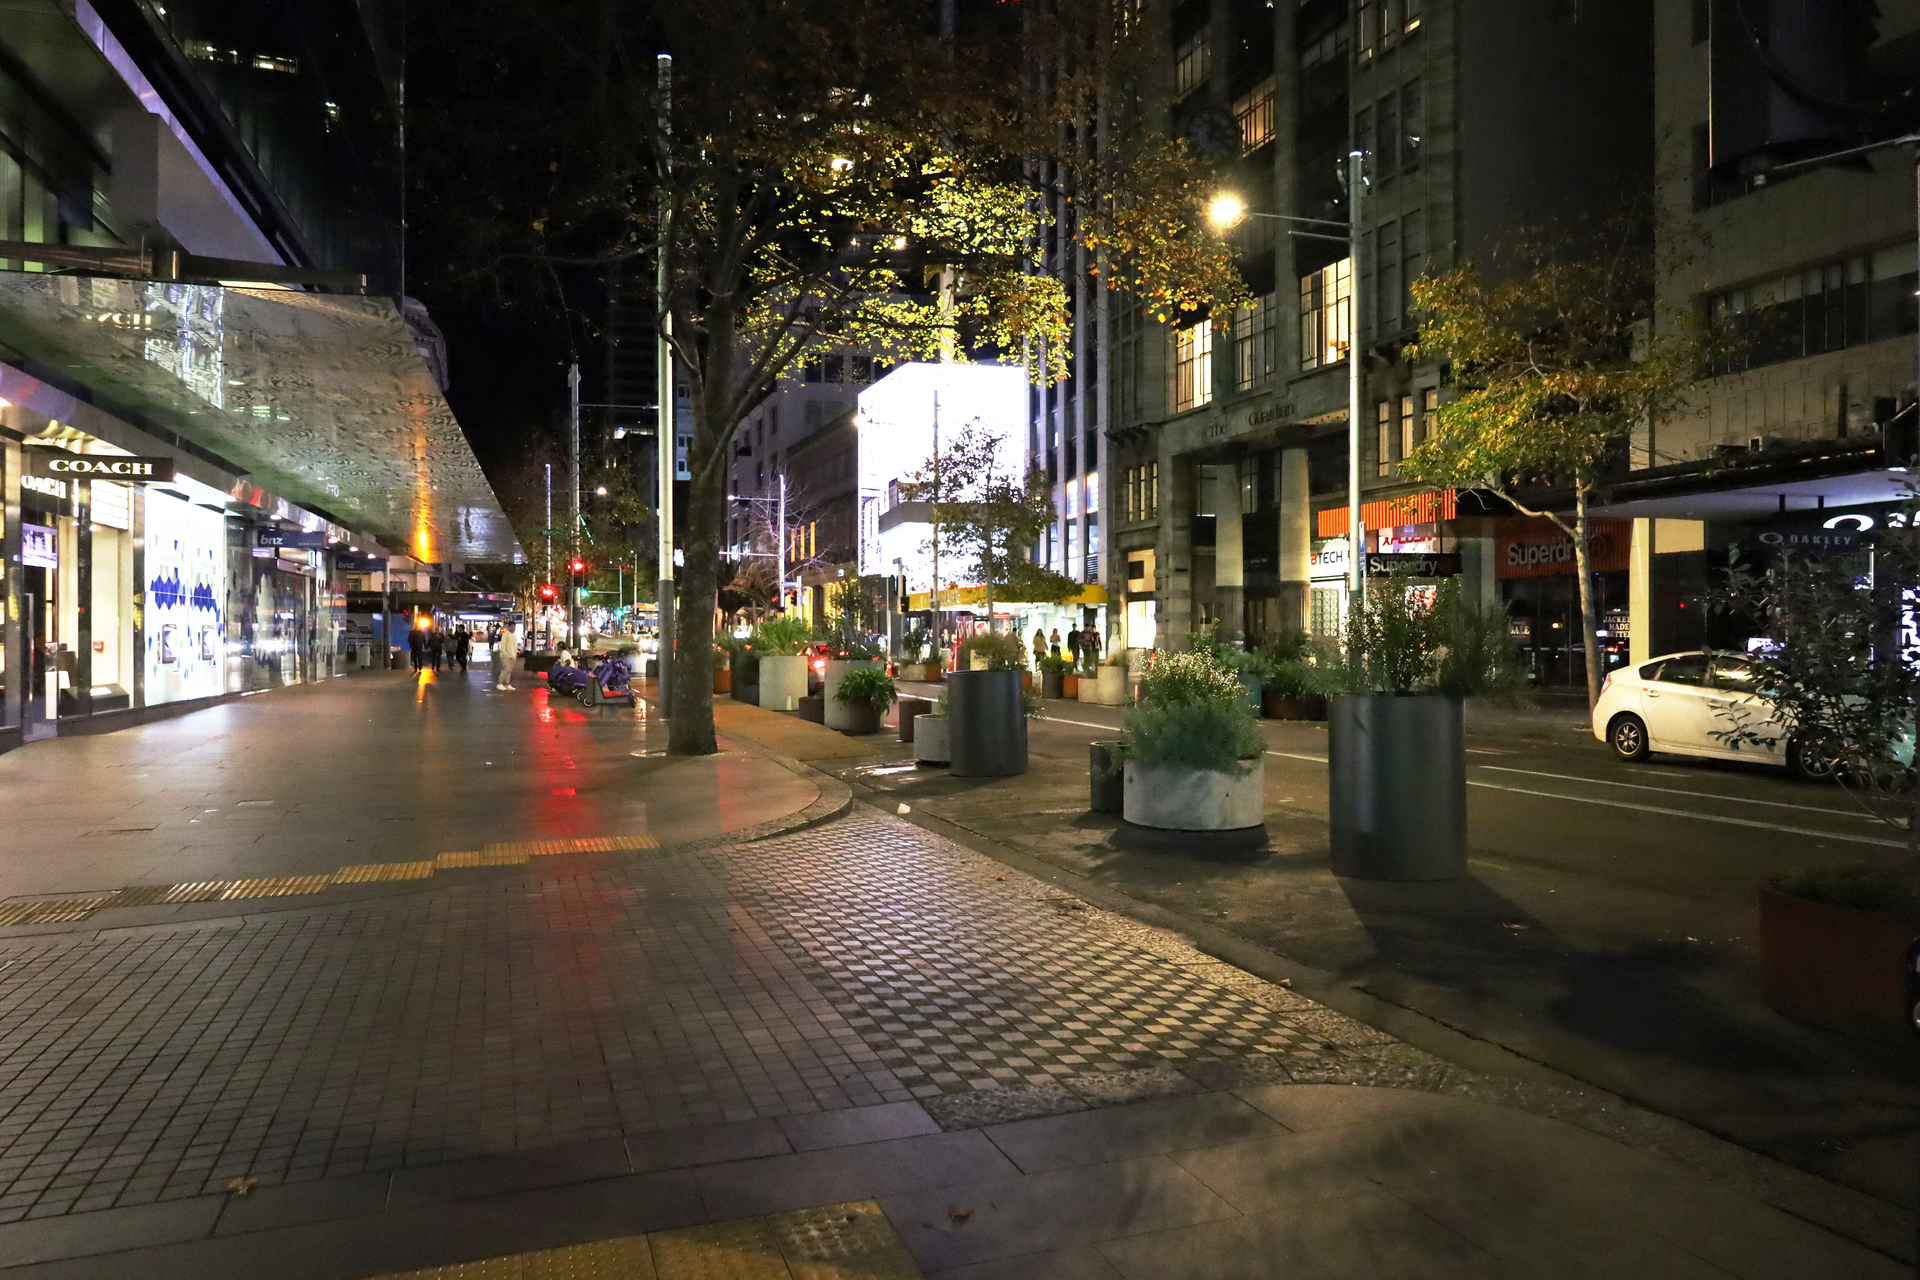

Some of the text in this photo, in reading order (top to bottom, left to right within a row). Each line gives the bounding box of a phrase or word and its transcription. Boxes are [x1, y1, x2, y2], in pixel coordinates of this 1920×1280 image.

[1206, 403, 1295, 438] The Guardian
[49, 459, 153, 475] COACH
[21, 475, 66, 498] OACH
[260, 535, 283, 545] bnz
[1790, 534, 1852, 546] OAKLEY
[1507, 537, 1574, 570] Superdr
[337, 561, 355, 569] bnz
